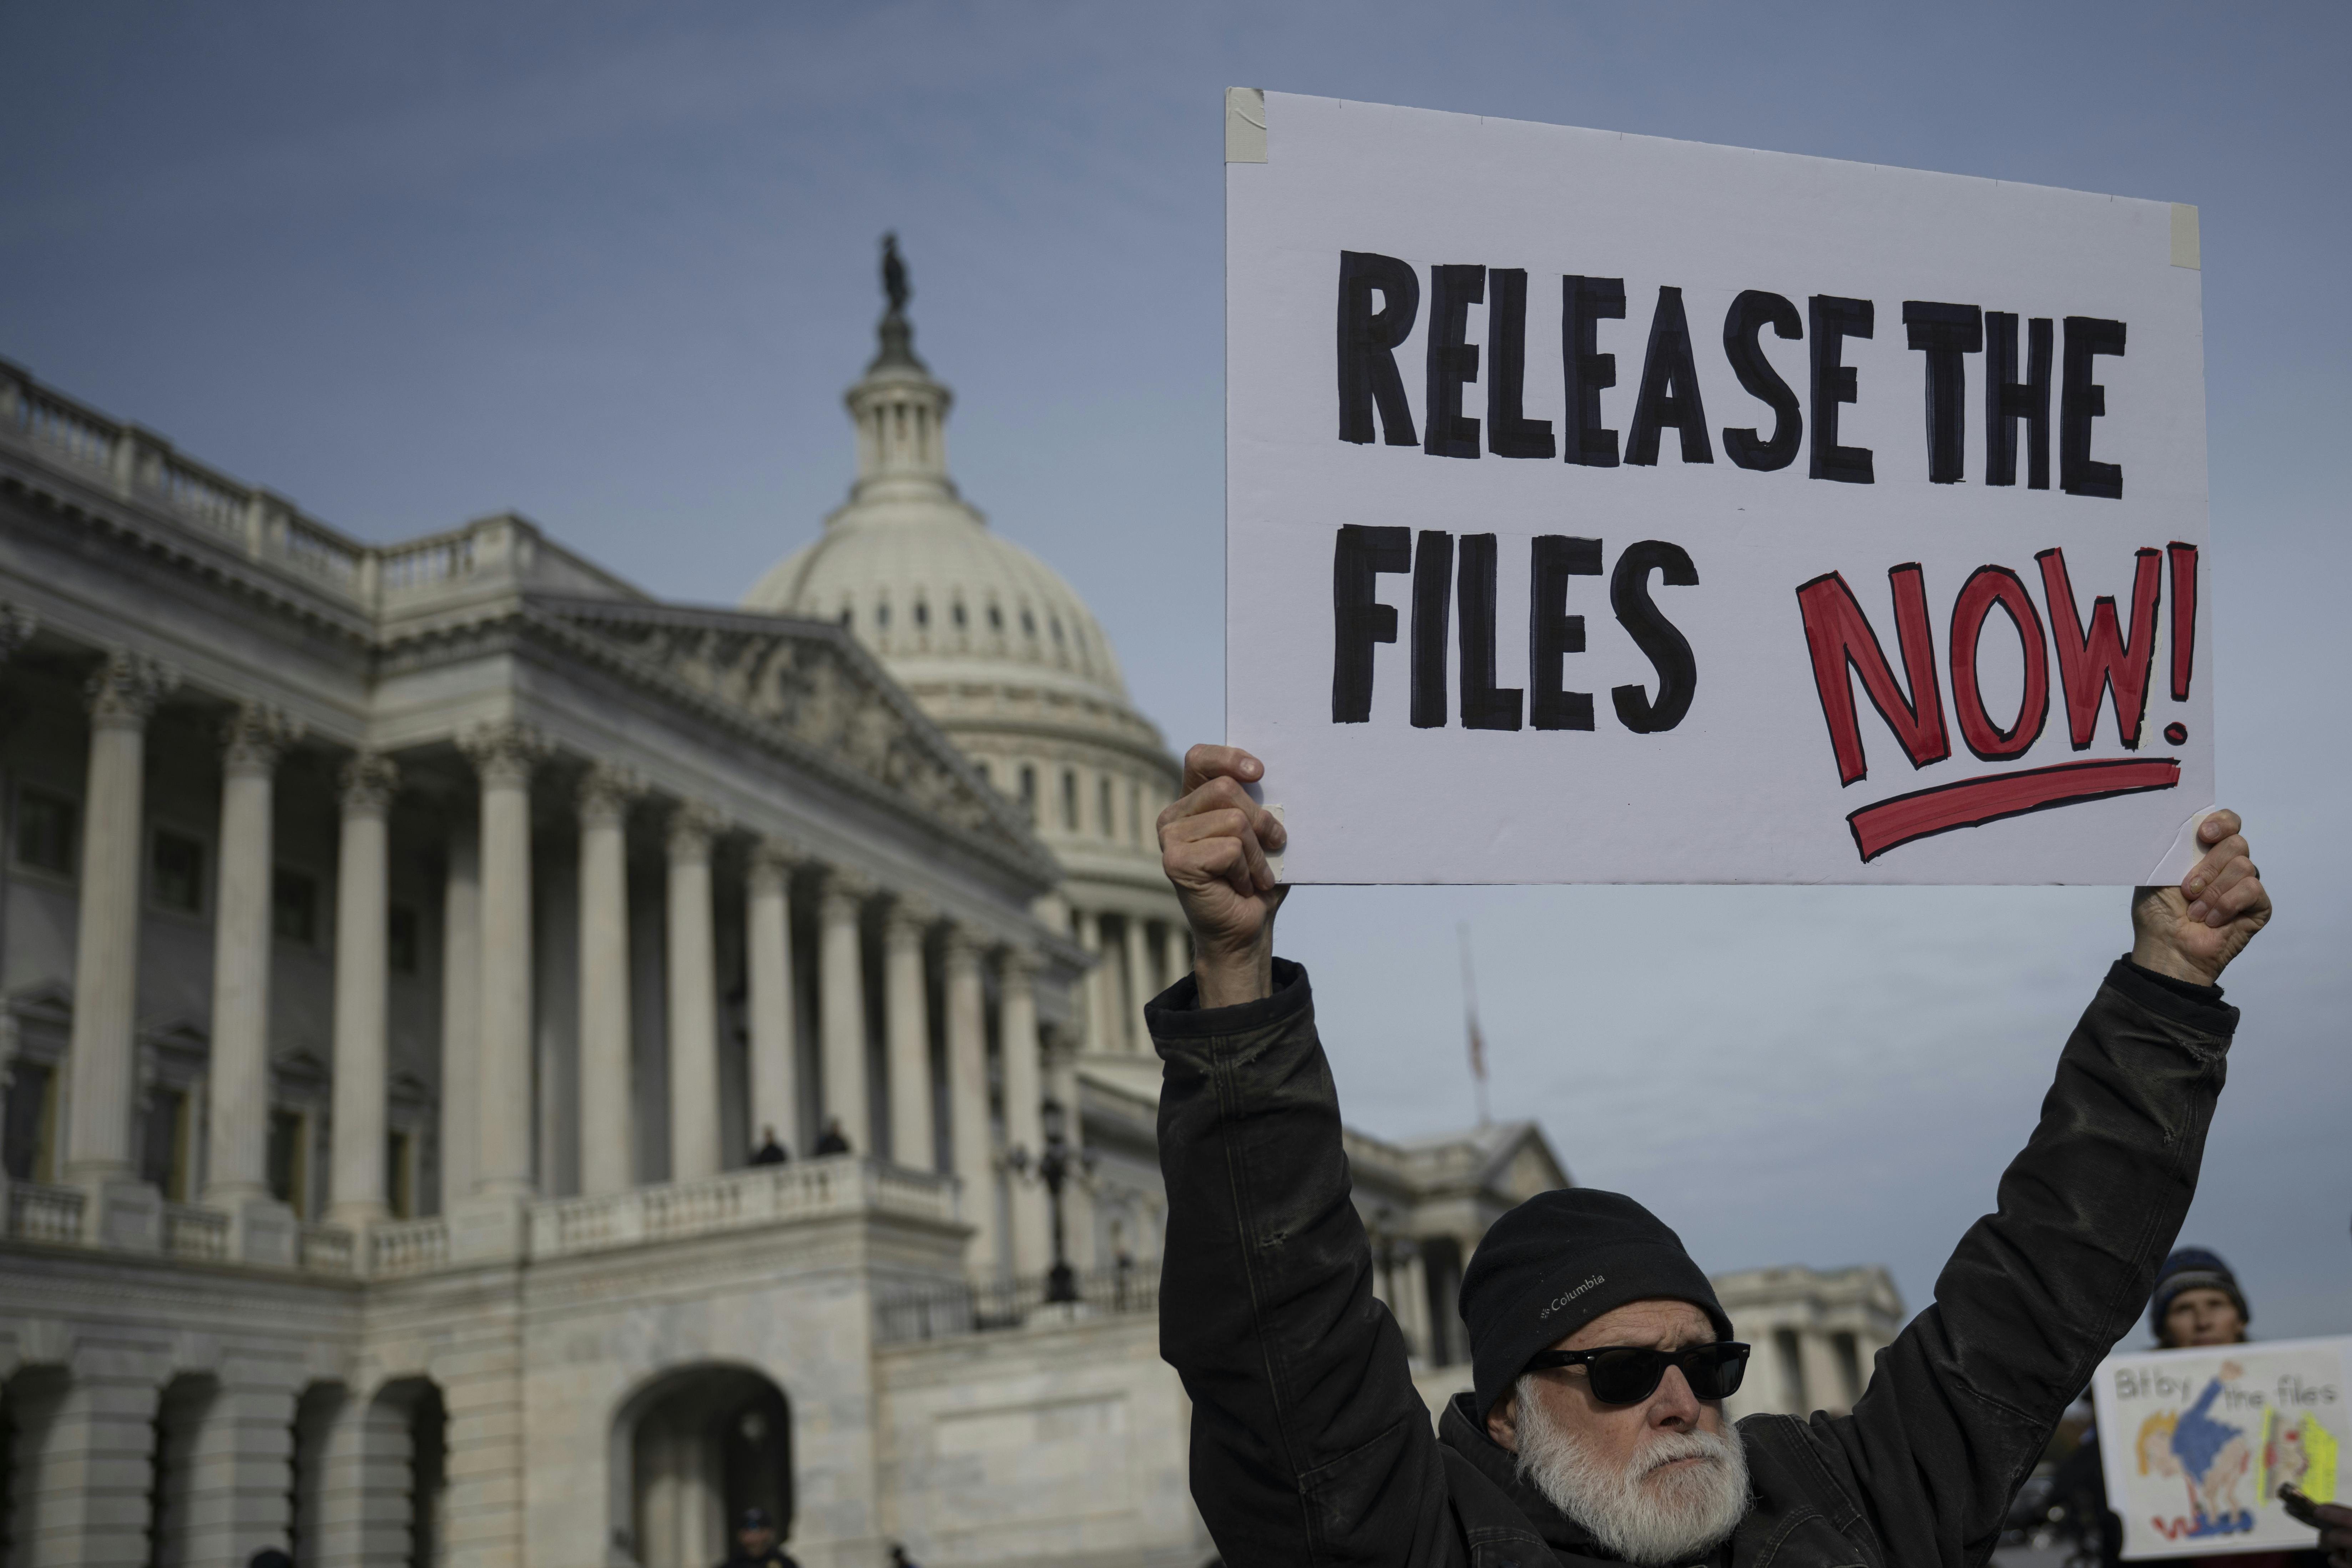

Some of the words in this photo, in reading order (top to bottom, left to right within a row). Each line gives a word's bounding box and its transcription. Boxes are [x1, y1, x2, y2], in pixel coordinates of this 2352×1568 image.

[1337, 250, 1875, 484] RELEASE
[1902, 301, 2127, 500] THE
[1332, 523, 1700, 734] FILES
[1795, 540, 2198, 789] NOW!
[1551, 1275, 1605, 1311] Columbia
[2224, 1383, 2266, 1411] the
[2275, 1374, 2338, 1406] files
